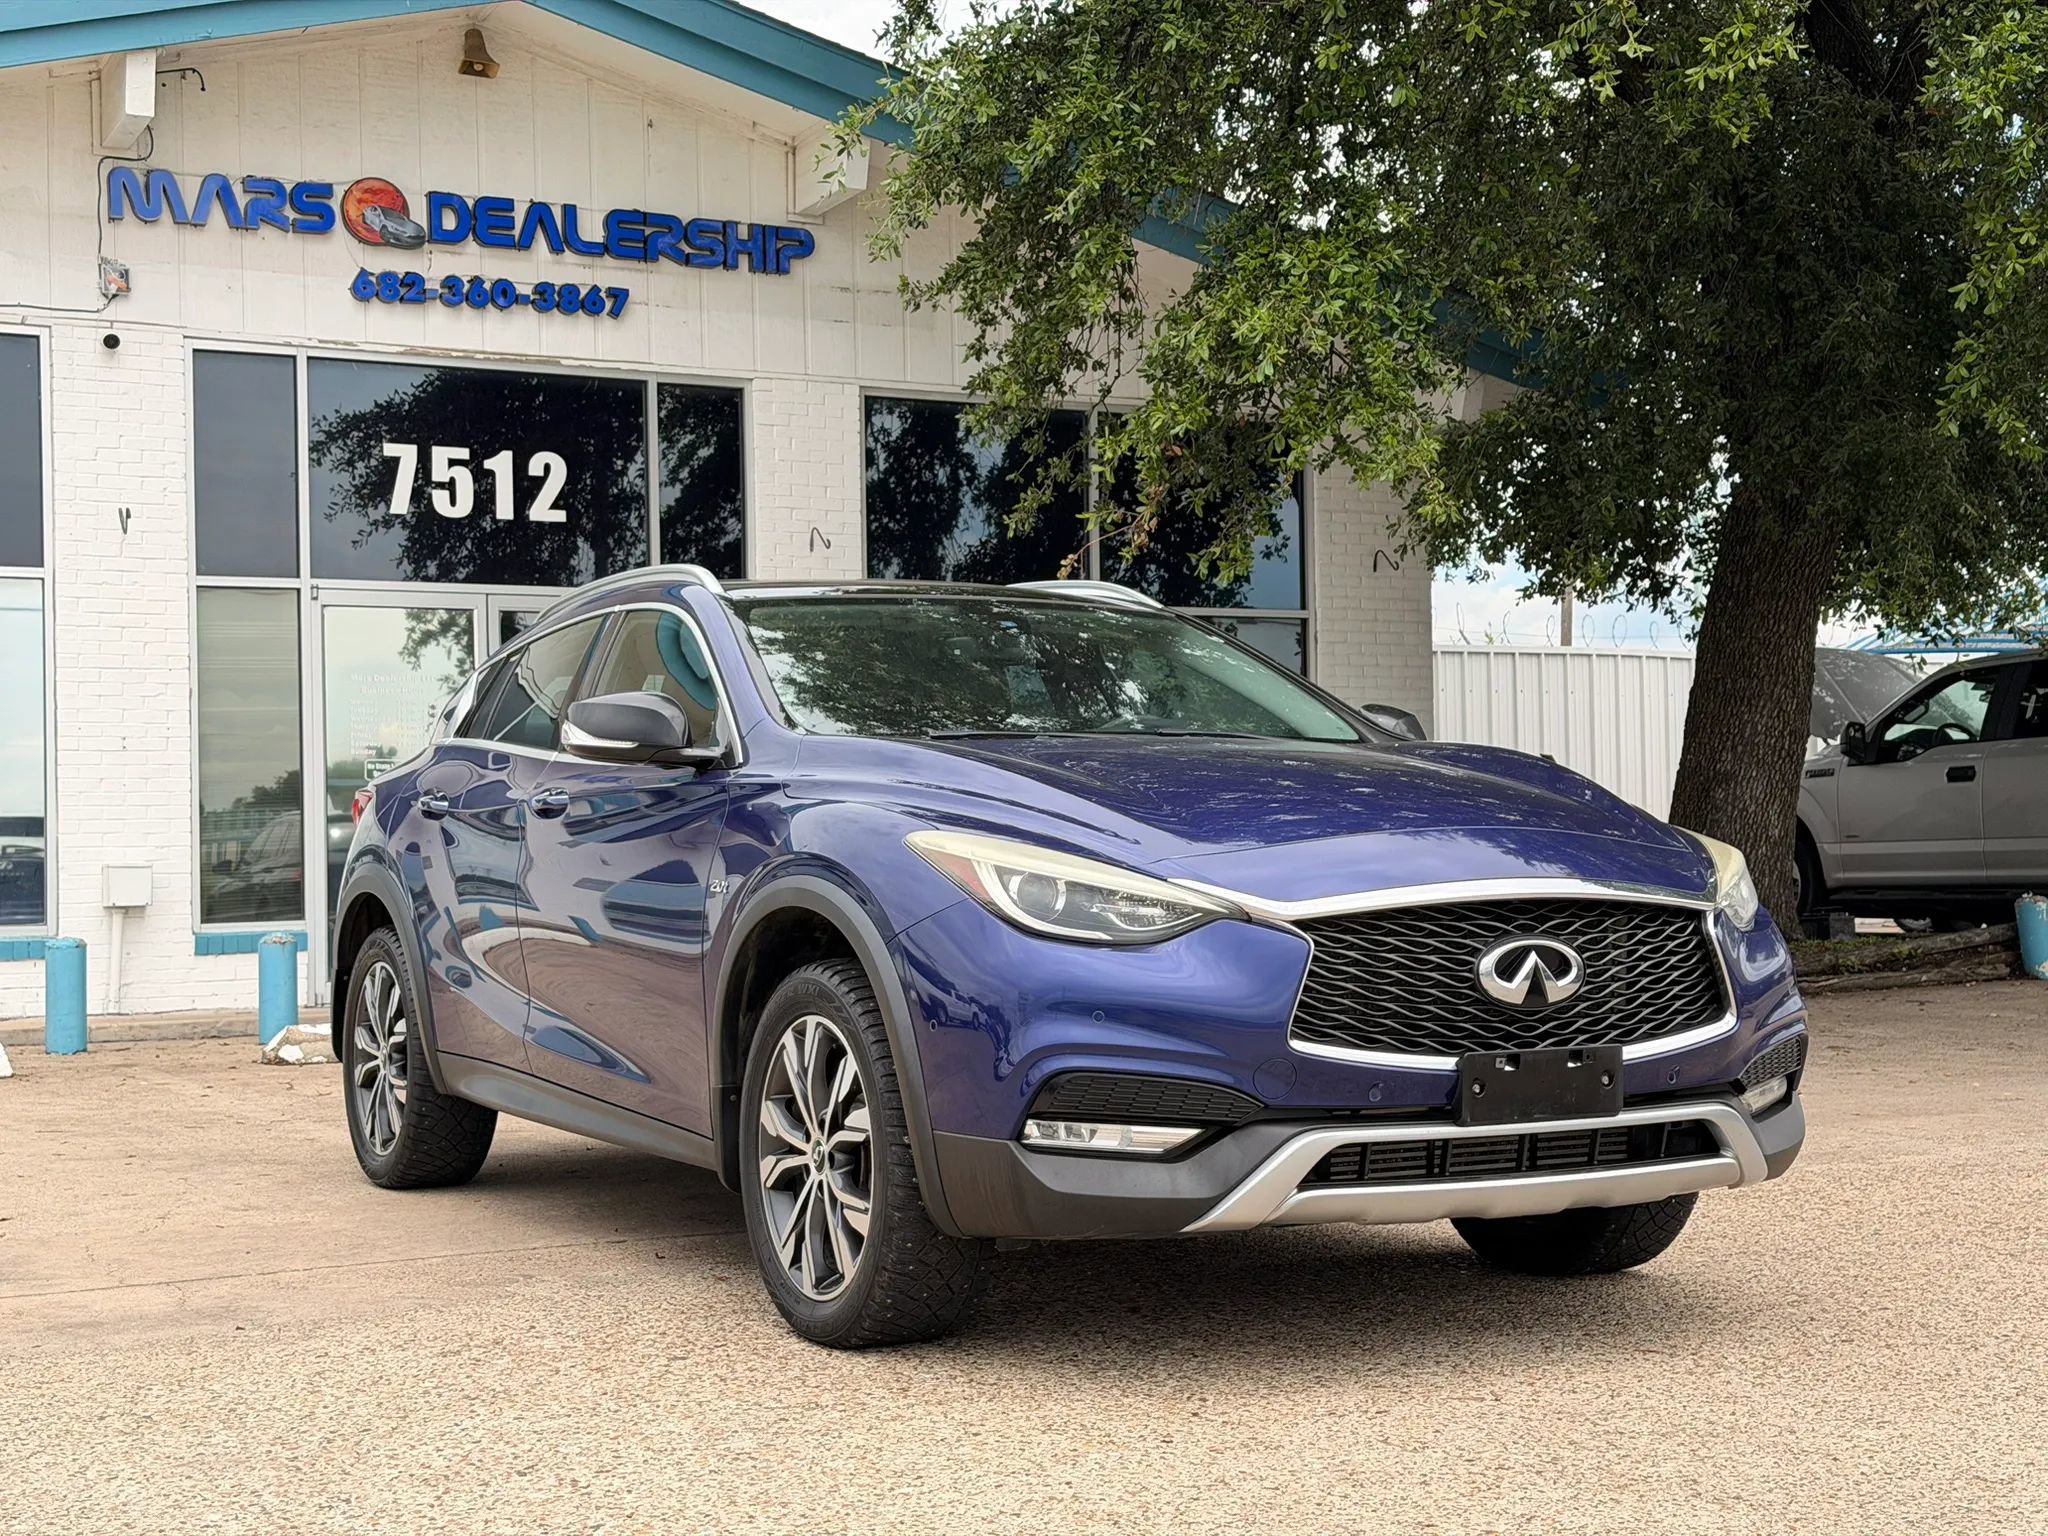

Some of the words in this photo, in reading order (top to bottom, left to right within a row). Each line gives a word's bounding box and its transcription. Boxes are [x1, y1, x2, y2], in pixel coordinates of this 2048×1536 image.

[107, 166, 338, 234] MARS
[425, 190, 816, 275] DEALERSHIP
[350, 267, 629, 319] 682-360-3867
[383, 443, 567, 522] 7512
